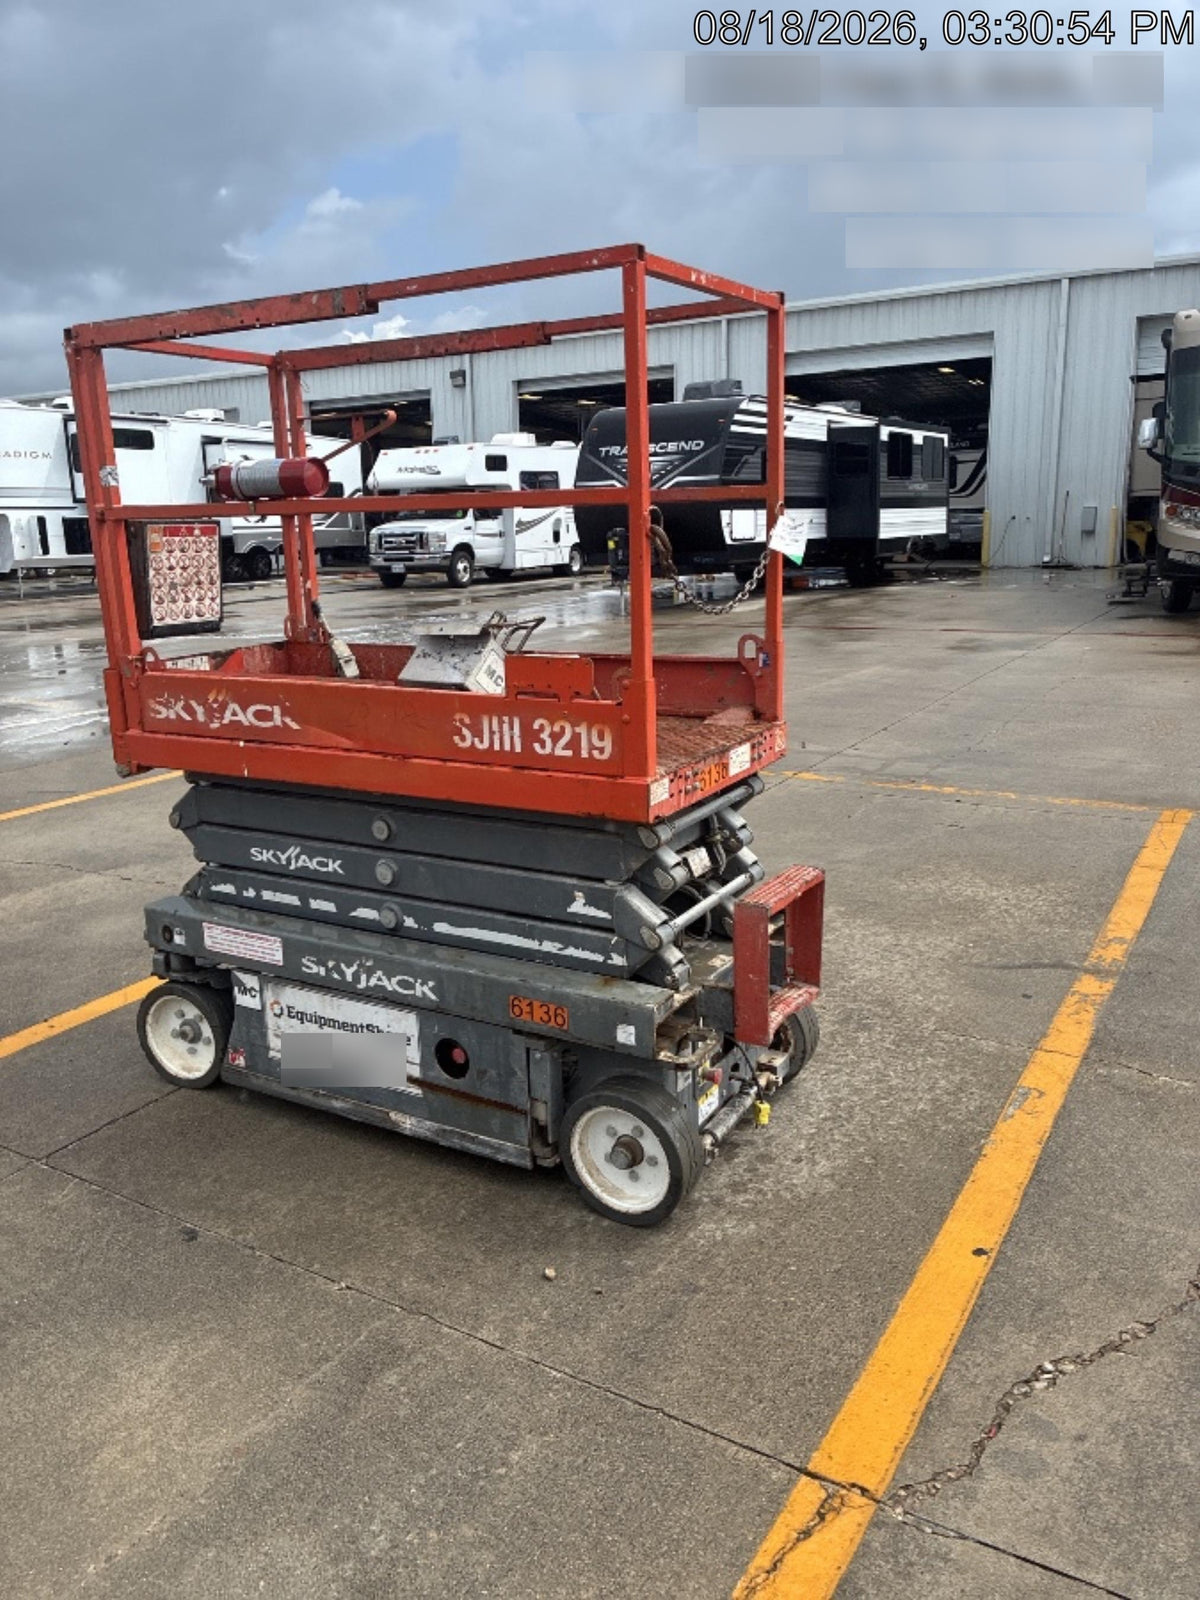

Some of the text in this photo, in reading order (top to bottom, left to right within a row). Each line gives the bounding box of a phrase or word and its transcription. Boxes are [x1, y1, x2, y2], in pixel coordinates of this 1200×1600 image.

[0, 450, 52, 460] ADIGM
[598, 440, 705, 457] TRASCEND
[533, 717, 613, 761] 3219
[249, 844, 346, 876] SKYJACK
[301, 955, 440, 1002] SKYJACK
[510, 997, 567, 1028] 6136
